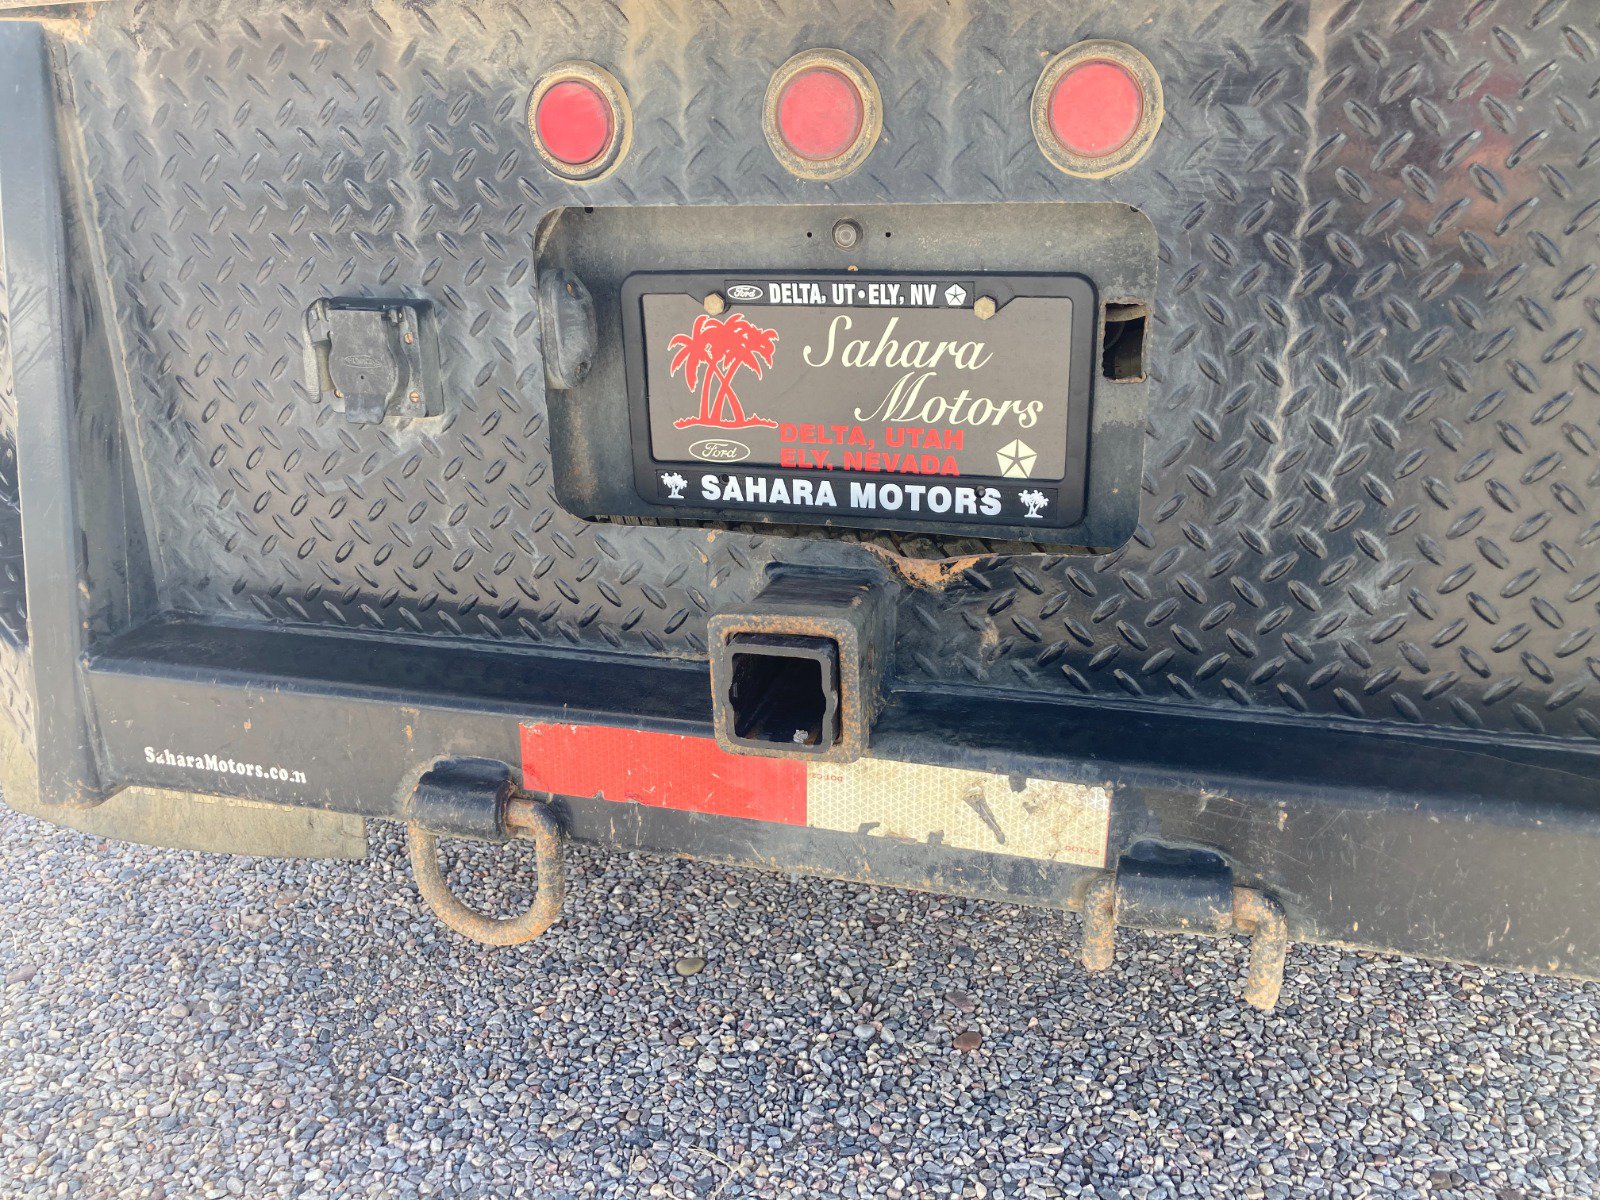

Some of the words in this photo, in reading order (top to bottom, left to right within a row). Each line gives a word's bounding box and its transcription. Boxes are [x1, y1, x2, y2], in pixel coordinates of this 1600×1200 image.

[731, 286, 758, 299] Ford
[769, 283, 826, 304] DELTA,
[910, 284, 937, 305] NV
[803, 315, 994, 370] Sahara
[854, 371, 1044, 428] Motors
[699, 441, 740, 460] Ford
[780, 423, 875, 451] DELTA,
[885, 427, 964, 451] UTAH
[780, 448, 834, 471] ELY,
[843, 451, 960, 476] NEVADA
[701, 474, 837, 507] SAHARA
[850, 482, 1002, 516] MOTORS
